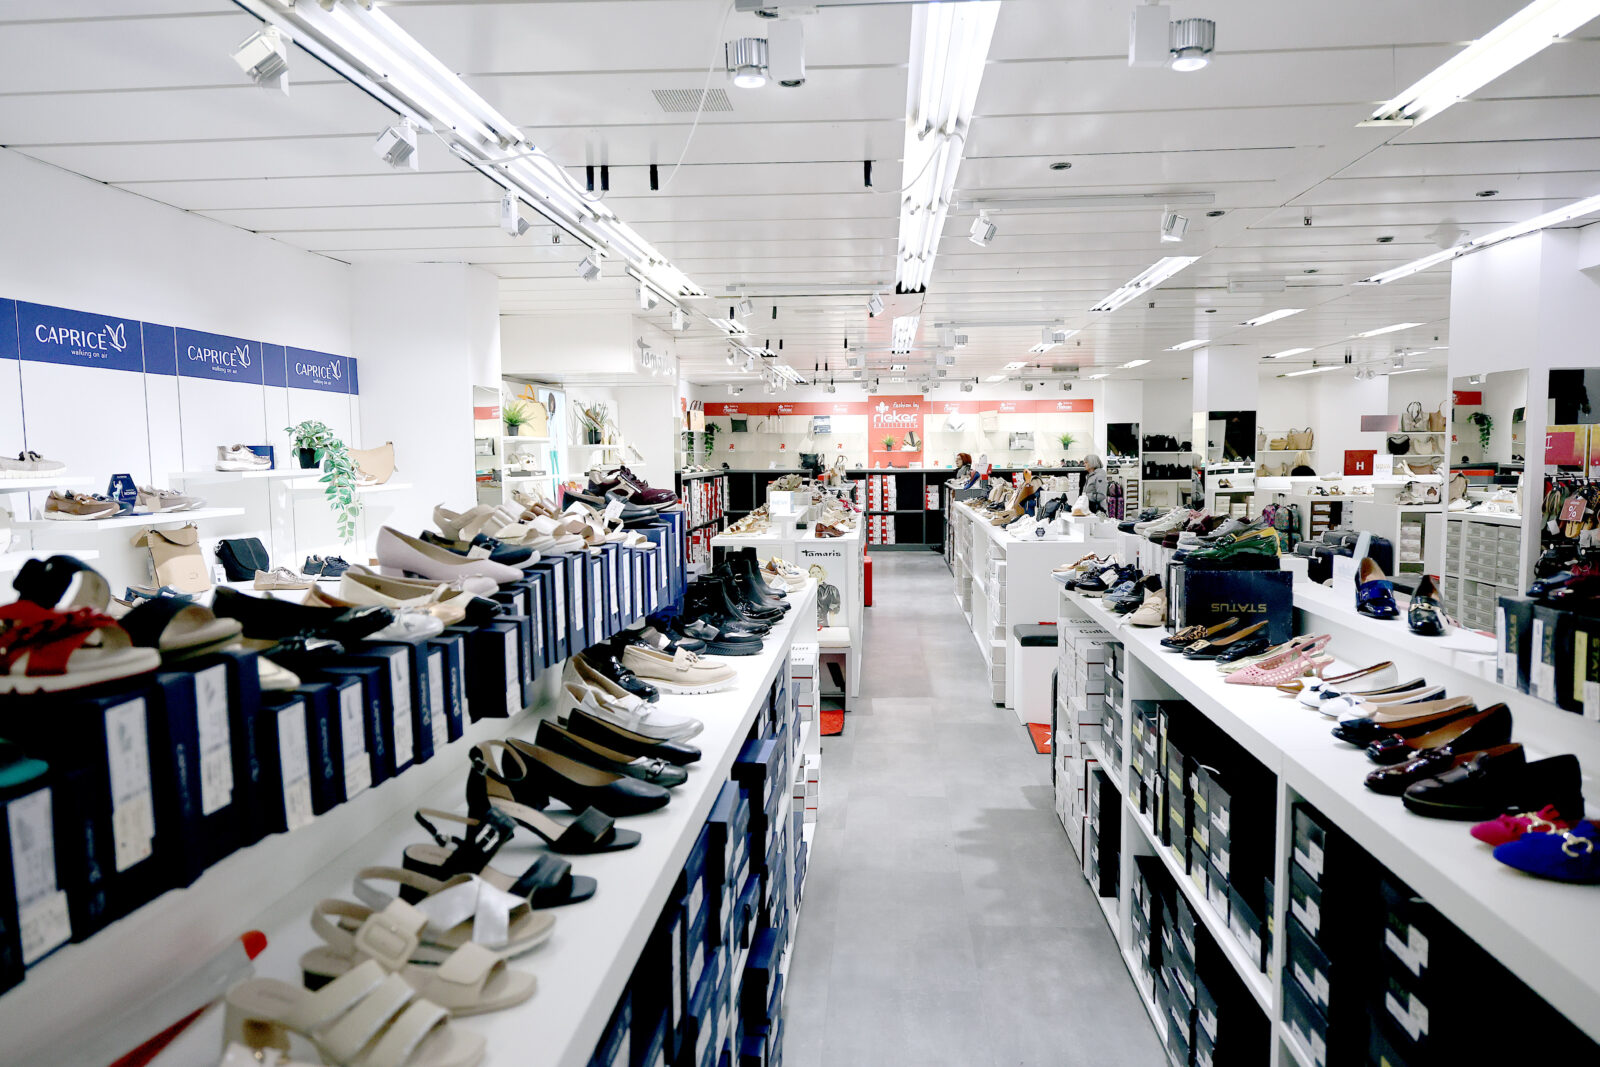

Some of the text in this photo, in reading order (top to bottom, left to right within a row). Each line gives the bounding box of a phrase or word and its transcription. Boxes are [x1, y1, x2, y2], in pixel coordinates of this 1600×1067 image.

[35, 324, 107, 350] CAPRICE
[71, 349, 92, 359] walking
[187, 345, 238, 367] CAPRICE
[295, 362, 332, 380] CAPRICE
[873, 409, 918, 424] rieker
[1356, 461, 1365, 471] H
[1211, 603, 1267, 613] STATUS
[1509, 614, 1518, 653] STAT
